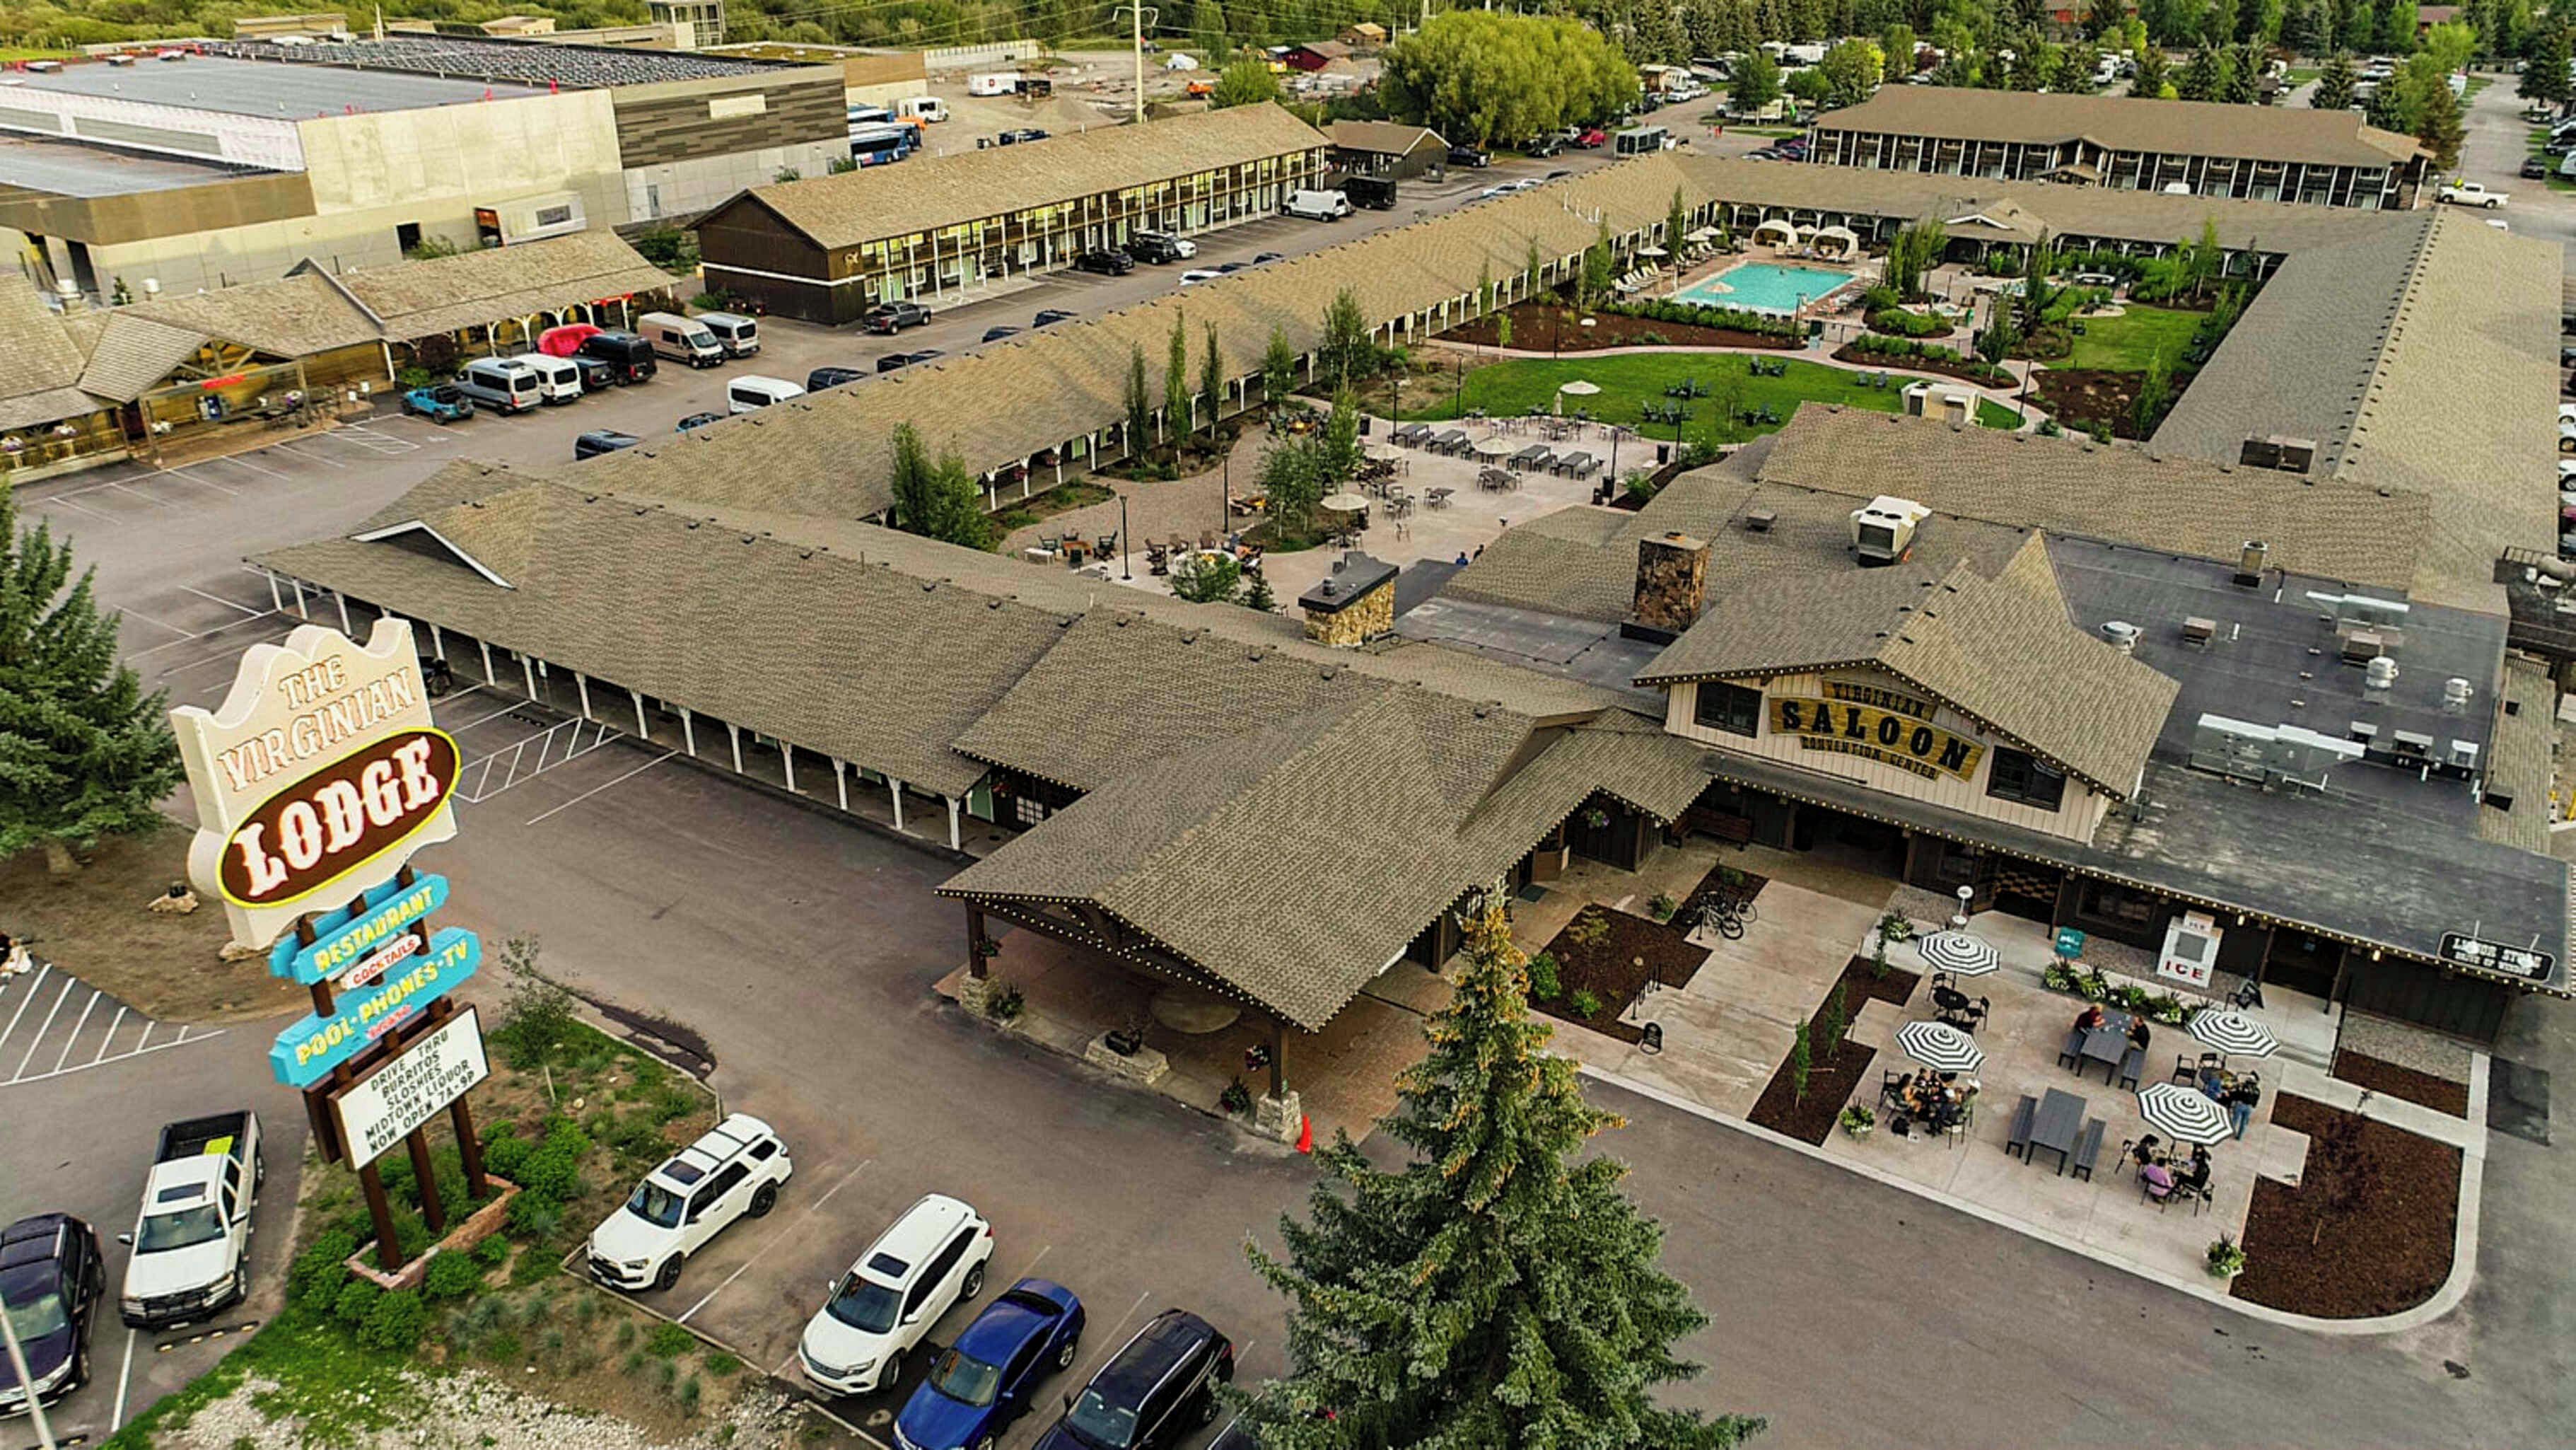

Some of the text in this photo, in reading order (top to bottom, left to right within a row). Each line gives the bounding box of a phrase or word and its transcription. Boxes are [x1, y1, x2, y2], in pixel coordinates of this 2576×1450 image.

[279, 654, 348, 710] THE
[218, 667, 417, 792] VIRGINIAN
[1782, 701, 1971, 772] SALOON
[1800, 735, 1937, 780] CONVENTION CENTER
[232, 736, 440, 898] LODGE
[314, 886, 435, 973] RESTAURANT
[353, 939, 416, 985] COCKTAILS
[2164, 960, 2205, 980] ICE
[371, 1030, 450, 1092] DRIVE THRU
[381, 1050, 441, 1098] BURRITOS
[387, 1063, 443, 1110] SLOSHIES
[364, 1060, 470, 1141] MIDTOWN LIQUOR
[368, 1127, 399, 1154] NOW
[402, 1101, 434, 1130] OPEN
